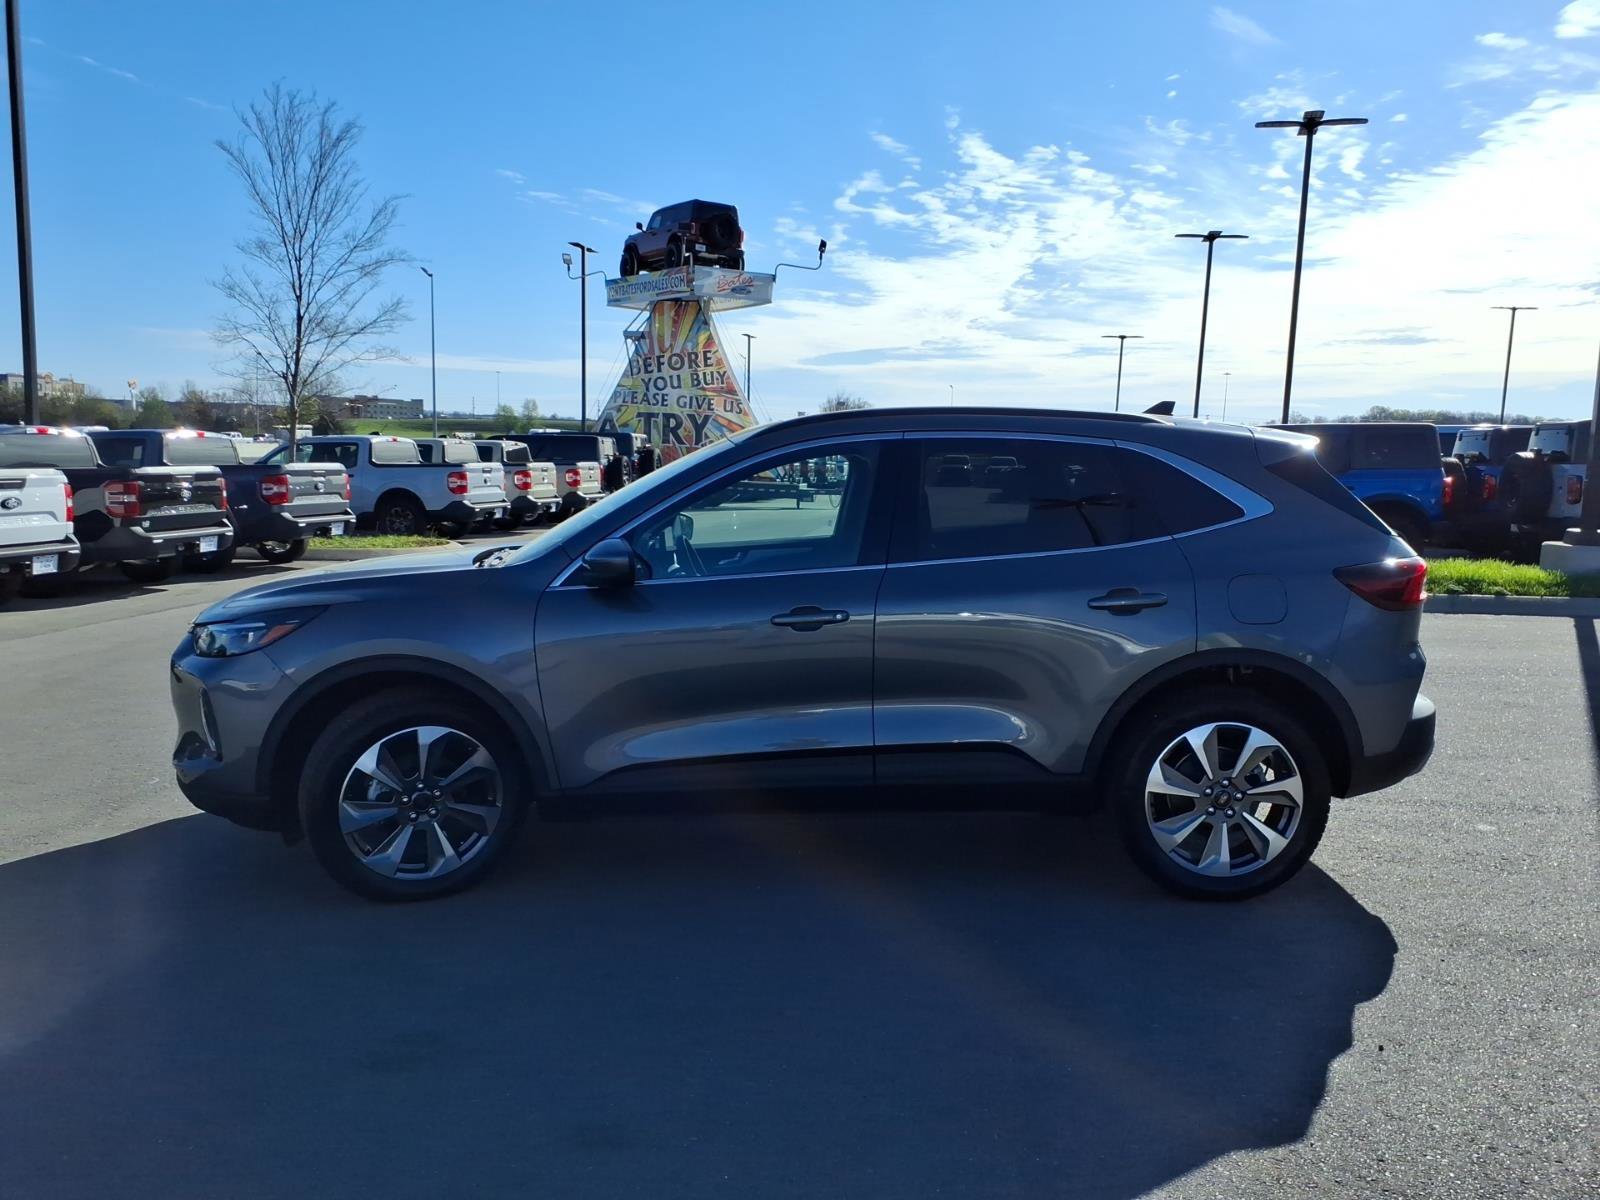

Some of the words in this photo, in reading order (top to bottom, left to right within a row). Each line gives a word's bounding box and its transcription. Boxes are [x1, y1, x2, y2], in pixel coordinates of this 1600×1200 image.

[630, 350, 714, 376] BEFORE
[641, 374, 682, 392] YOU
[691, 370, 728, 388] BUY
[613, 391, 669, 407] PLEASE
[676, 395, 715, 411] GIVE
[724, 400, 743, 415] US
[598, 414, 619, 433] A
[636, 411, 714, 446] TRY
